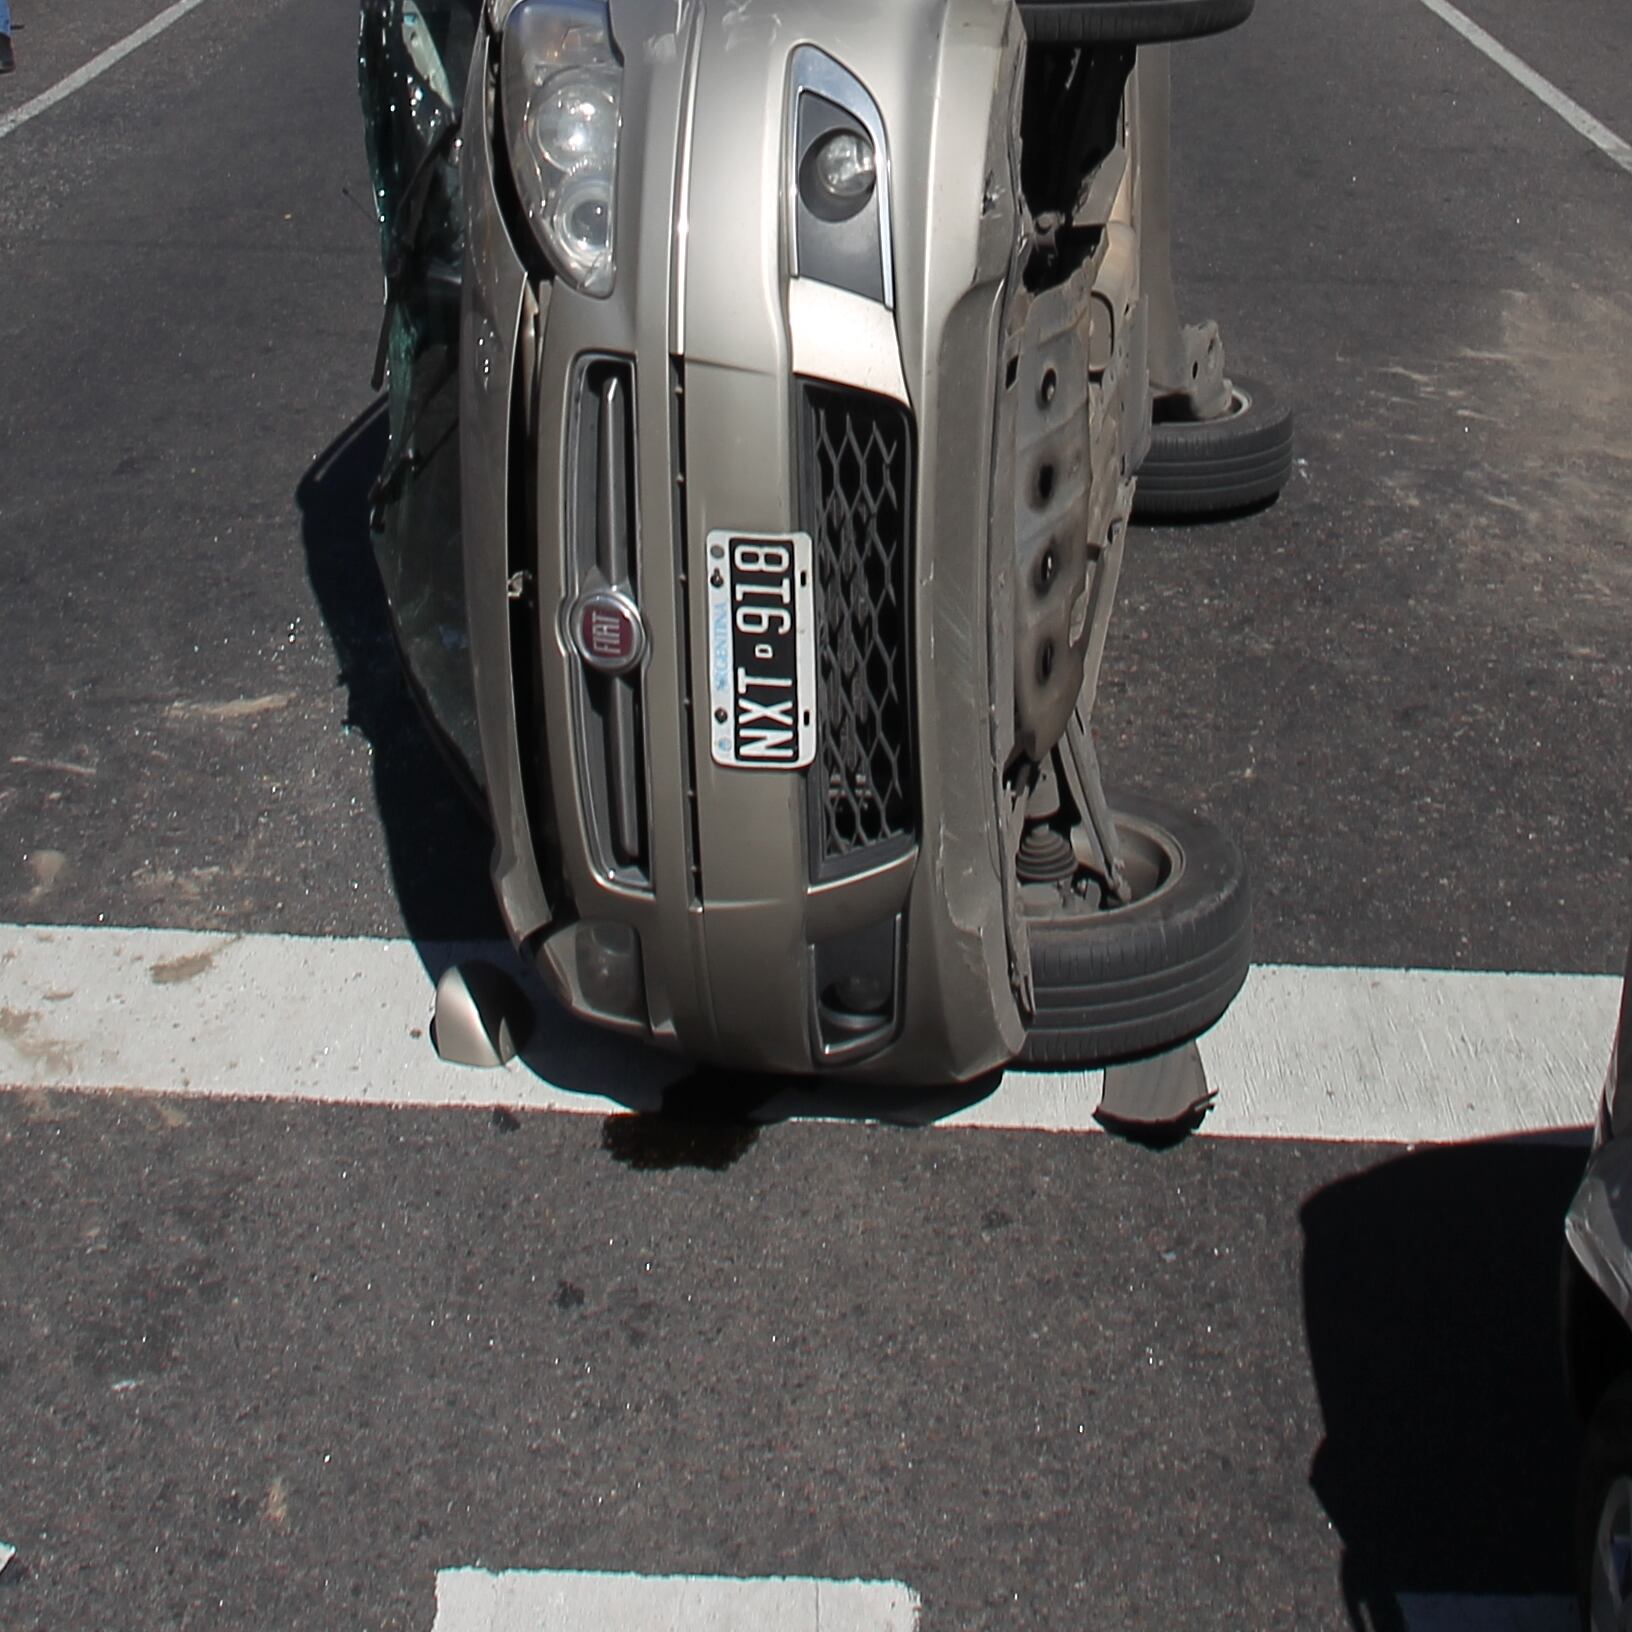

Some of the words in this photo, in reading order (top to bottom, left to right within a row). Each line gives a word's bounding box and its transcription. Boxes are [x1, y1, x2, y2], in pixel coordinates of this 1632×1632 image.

[591, 611, 621, 654] FIAT
[734, 544, 792, 635] 918
[713, 601, 730, 690] ARGENTINA
[736, 667, 794, 758] NXT
